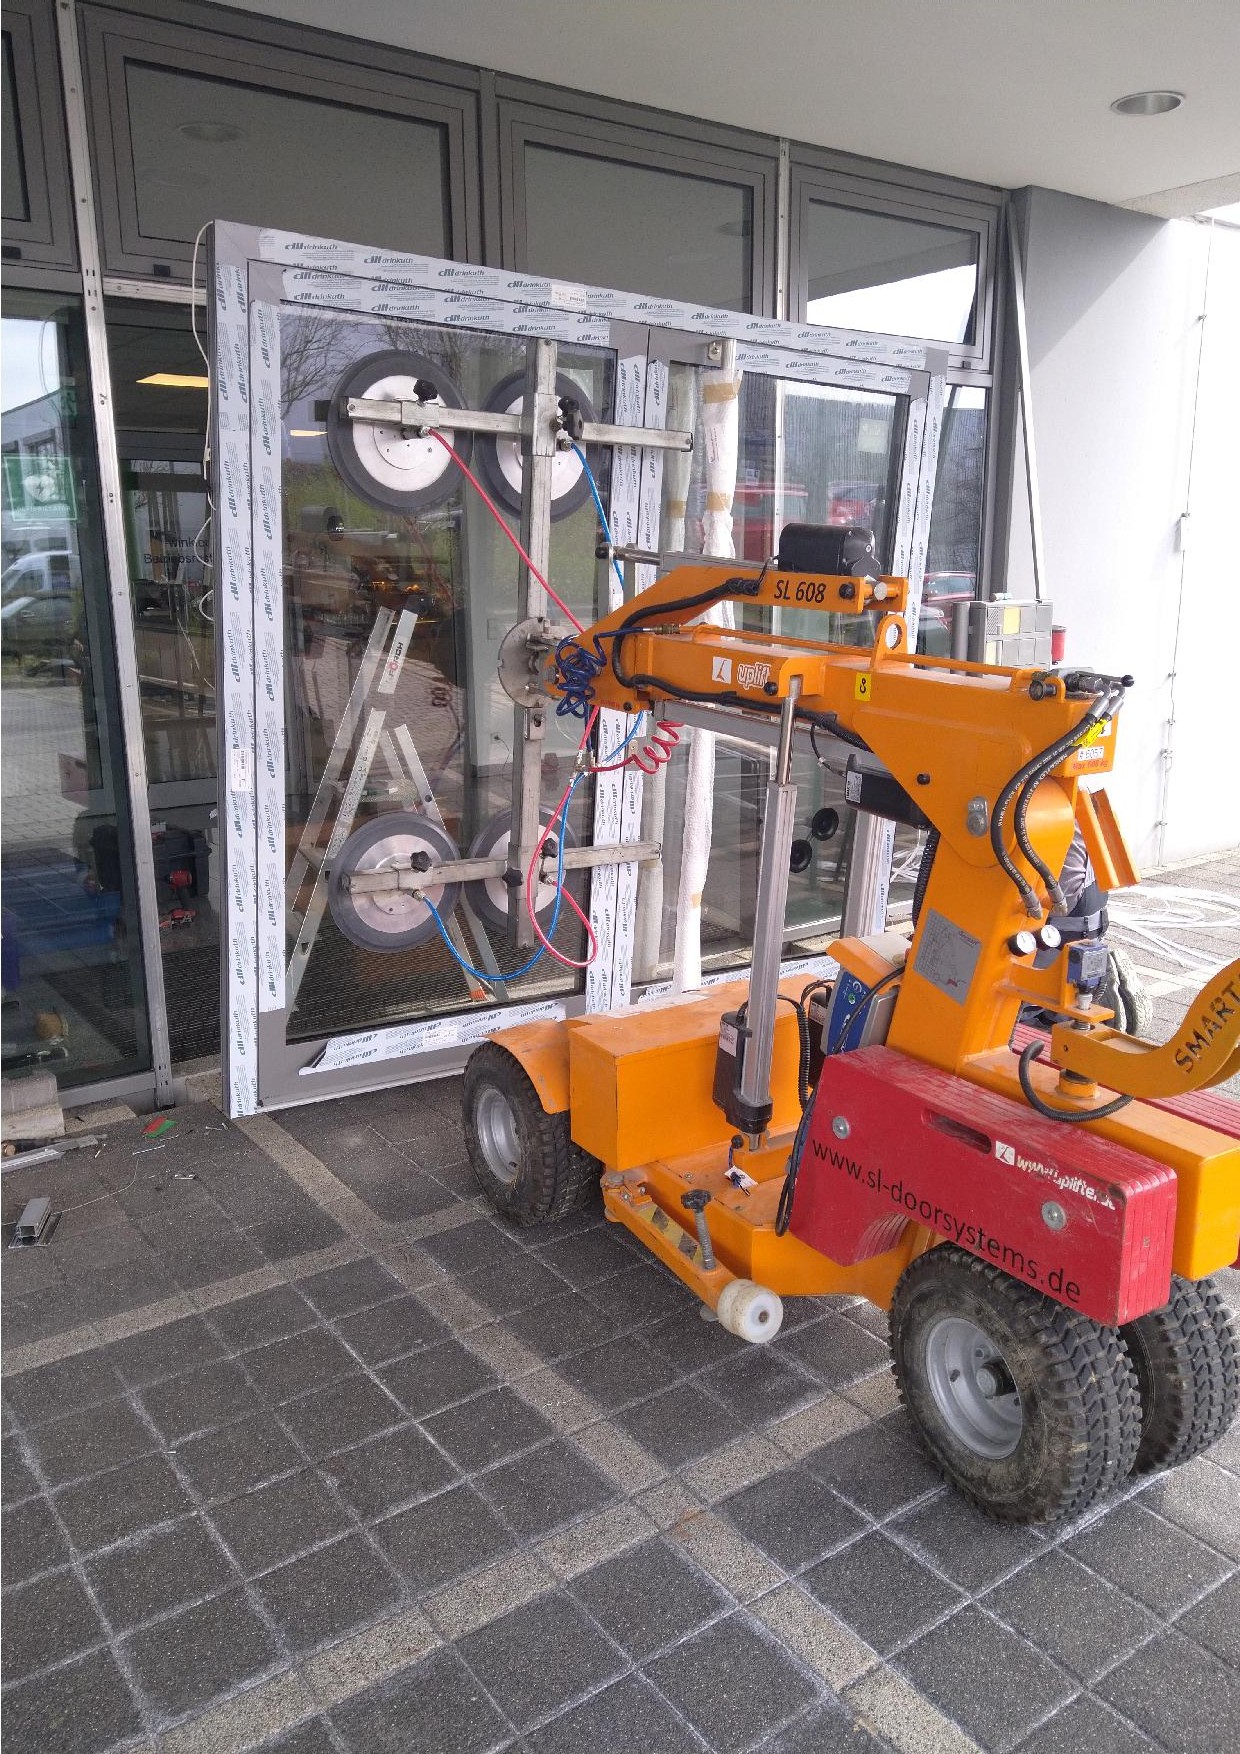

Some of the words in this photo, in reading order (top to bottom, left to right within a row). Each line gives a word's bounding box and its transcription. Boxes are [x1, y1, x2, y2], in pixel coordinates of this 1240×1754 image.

[774, 579, 791, 600] SL
[795, 581, 827, 603] 608
[811, 1138, 1081, 1304] www.sl-doorsystems.de
